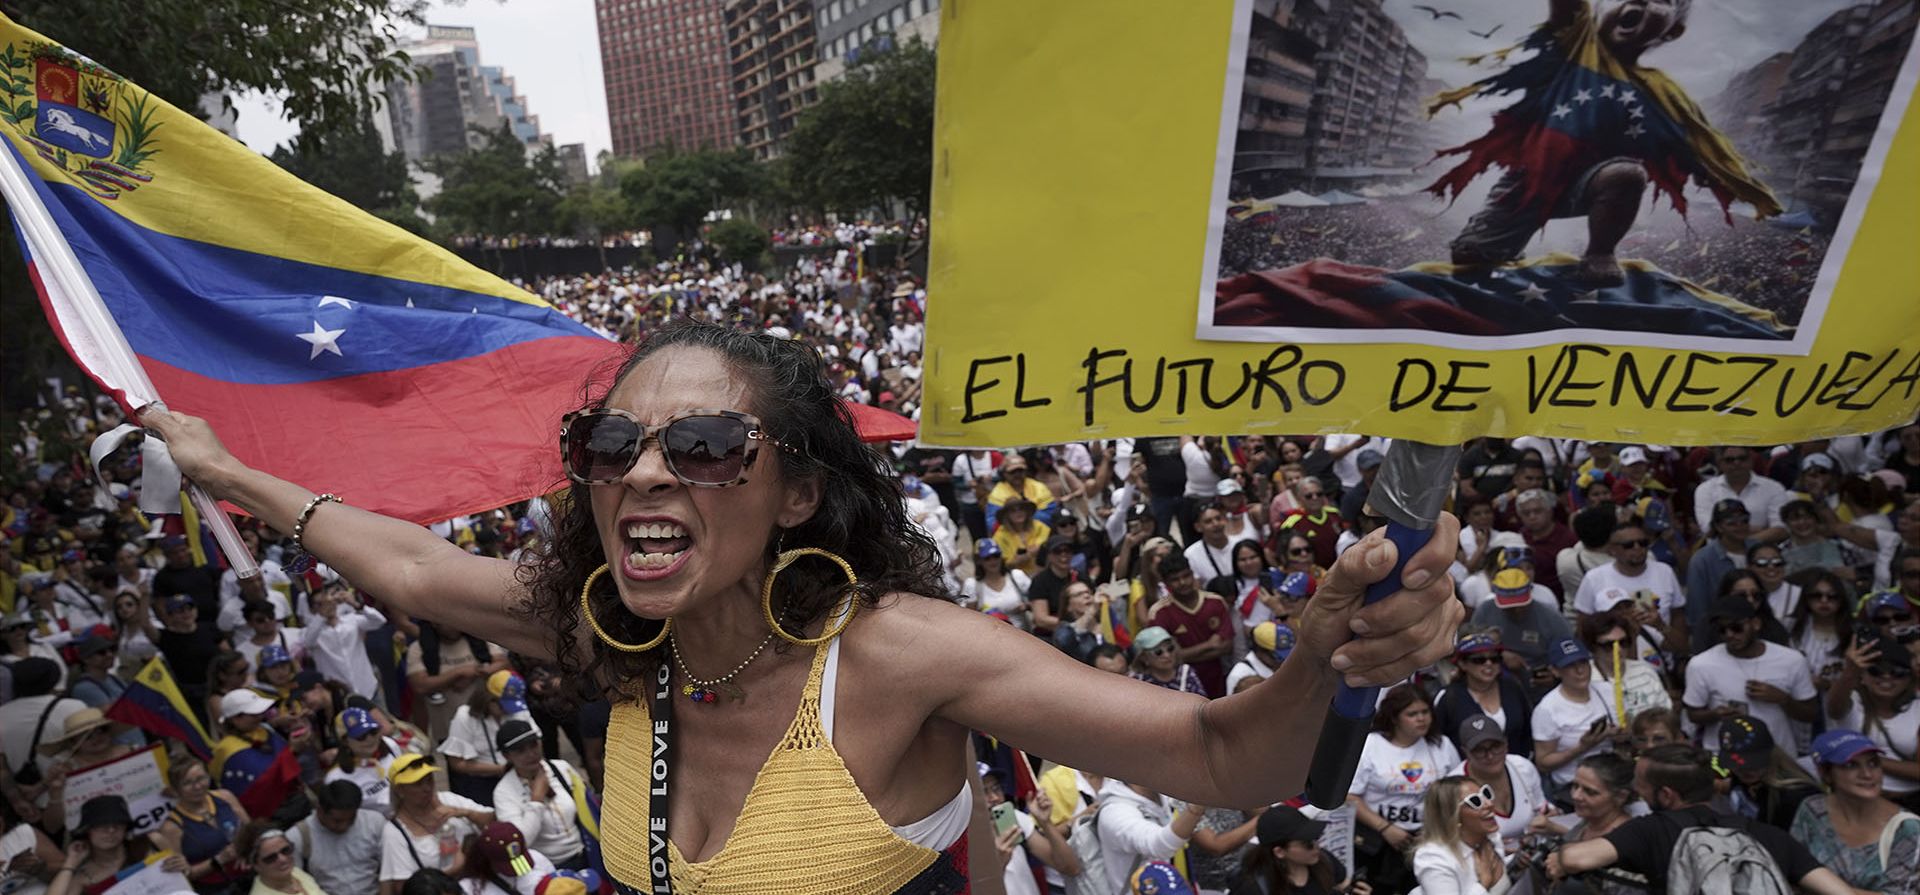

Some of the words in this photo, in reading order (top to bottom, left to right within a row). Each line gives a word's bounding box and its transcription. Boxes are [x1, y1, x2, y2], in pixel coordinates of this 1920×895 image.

[961, 353, 1052, 424] EL
[1077, 345, 1346, 427] FUTURO
[1389, 357, 1492, 412] DE
[1527, 345, 1920, 418] VENEZUELA
[656, 664, 669, 699] LO
[652, 720, 669, 796] LOVE
[650, 817, 671, 893] LOVE
